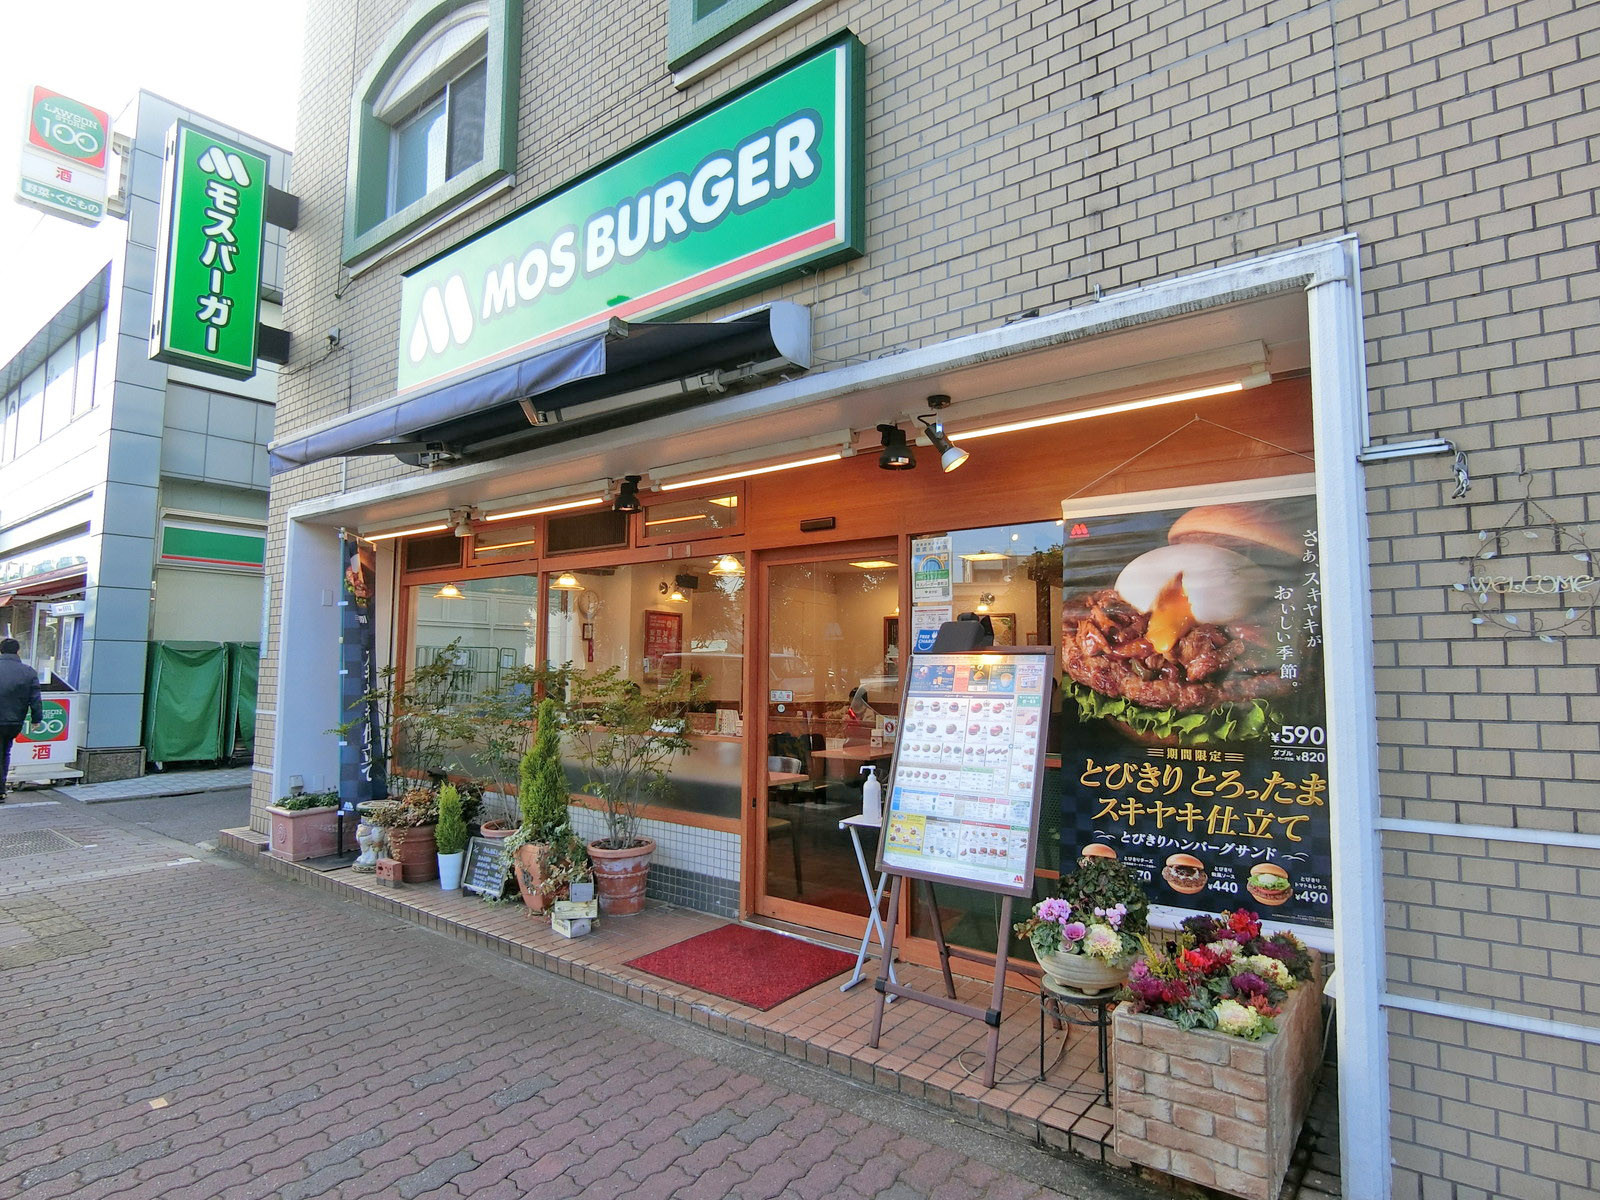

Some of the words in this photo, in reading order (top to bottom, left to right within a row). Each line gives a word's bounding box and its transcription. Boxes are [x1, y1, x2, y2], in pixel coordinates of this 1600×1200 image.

[44, 103, 98, 130] LAWSON
[55, 115, 87, 130] STORE
[42, 117, 98, 152] 100
[56, 167, 72, 183] 酒
[25, 184, 99, 213] 野菜・くだもの
[482, 231, 576, 320] MOS
[586, 117, 816, 274] BURGER
[199, 180, 238, 352] モスバーガー
[1302, 529, 1322, 648] さあ、スキヤキが
[1274, 585, 1298, 687] おいしい季節。
[1271, 725, 1325, 745] ¥590
[32, 744, 51, 760] 酒
[1166, 747, 1223, 763] 期間限定
[1273, 749, 1294, 757] ダブル
[1295, 751, 1326, 763] ¥820
[1080, 758, 1184, 796] とびきり
[1191, 765, 1328, 806] とろったま
[1091, 797, 1310, 842] スキヤキ仕立て
[1120, 831, 1277, 860] とびきりハンバーグサンド
[1208, 880, 1239, 894] ¥440
[1294, 890, 1329, 904] ¥490
